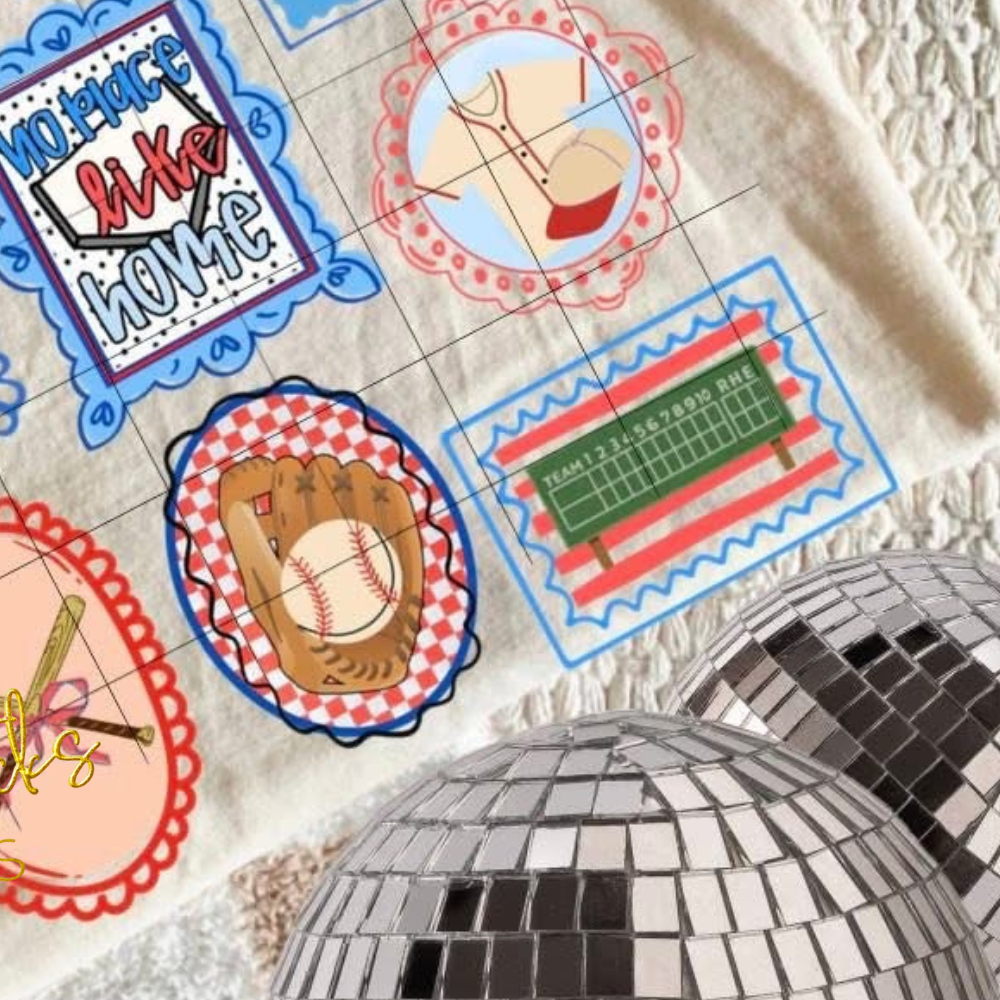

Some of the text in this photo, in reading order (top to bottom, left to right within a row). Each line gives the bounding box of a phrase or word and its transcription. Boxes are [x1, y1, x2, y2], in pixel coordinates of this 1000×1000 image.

[76, 125, 228, 236] like
[78, 191, 271, 345] home
[542, 459, 584, 488] TEAM
